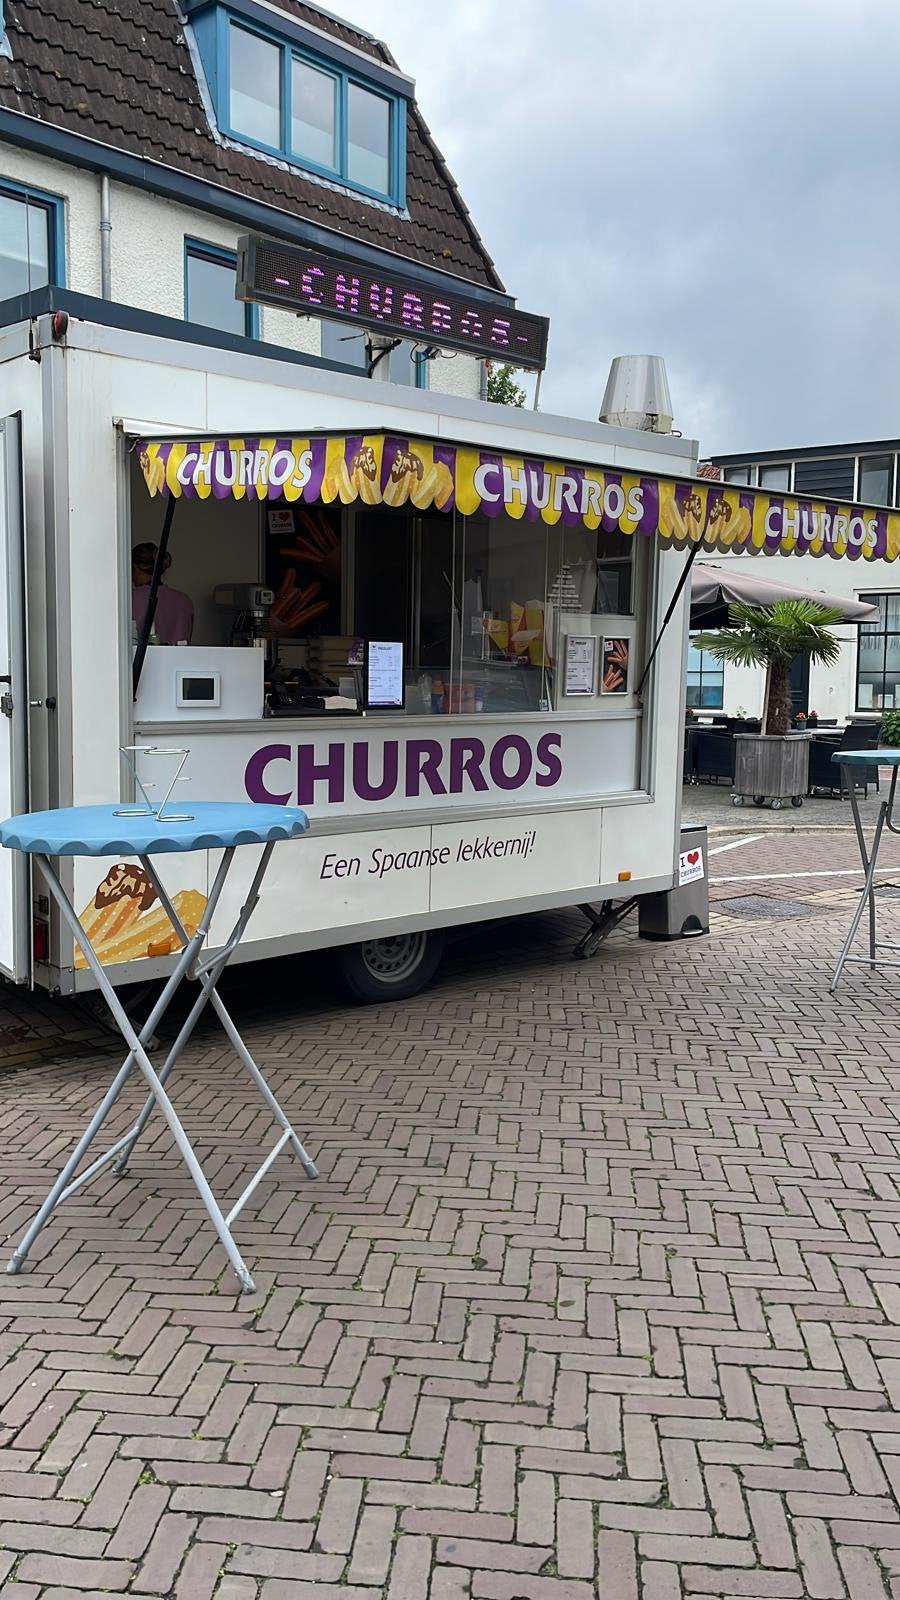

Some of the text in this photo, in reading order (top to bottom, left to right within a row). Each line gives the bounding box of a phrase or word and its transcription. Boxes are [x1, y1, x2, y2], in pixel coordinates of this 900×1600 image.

[176, 449, 313, 488] CHURROS
[473, 463, 645, 522] CHURROS
[763, 506, 879, 548] CHURROS
[244, 732, 563, 806] CHURROS
[319, 830, 537, 880] Een Spaanse lekkernij!
[680, 857, 685, 868] I
